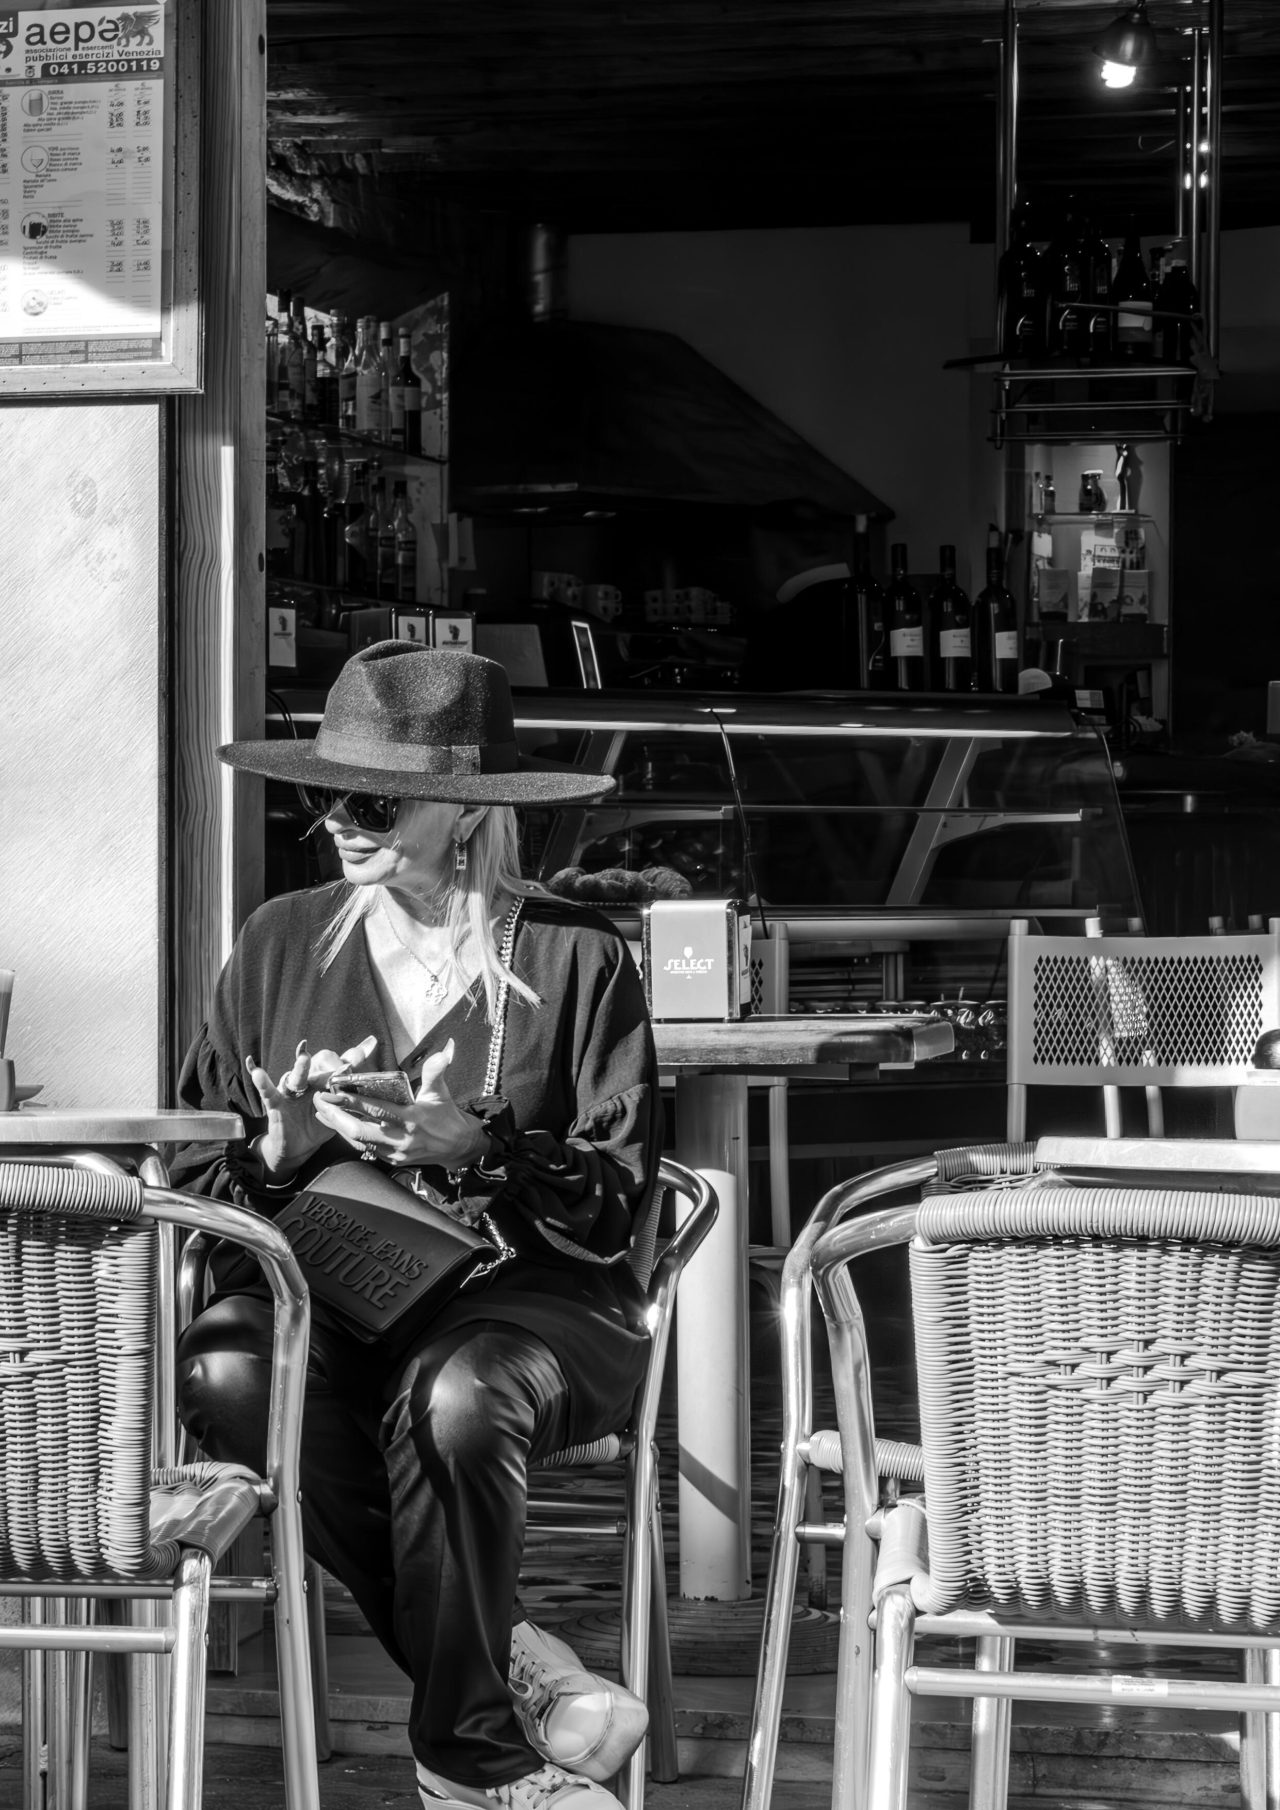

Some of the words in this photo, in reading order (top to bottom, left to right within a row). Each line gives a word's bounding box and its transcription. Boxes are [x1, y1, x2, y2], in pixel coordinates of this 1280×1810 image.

[25, 46, 72, 55] associazione
[25, 50, 68, 63] pubblici
[72, 49, 114, 60] esercizi
[117, 48, 161, 58] Venezia
[49, 59, 160, 76] 041.5200119
[663, 958, 715, 971] SELECT
[300, 1196, 376, 1248] VERSACE
[366, 1238, 429, 1280] JEANS
[281, 1216, 411, 1310] COUTURE
